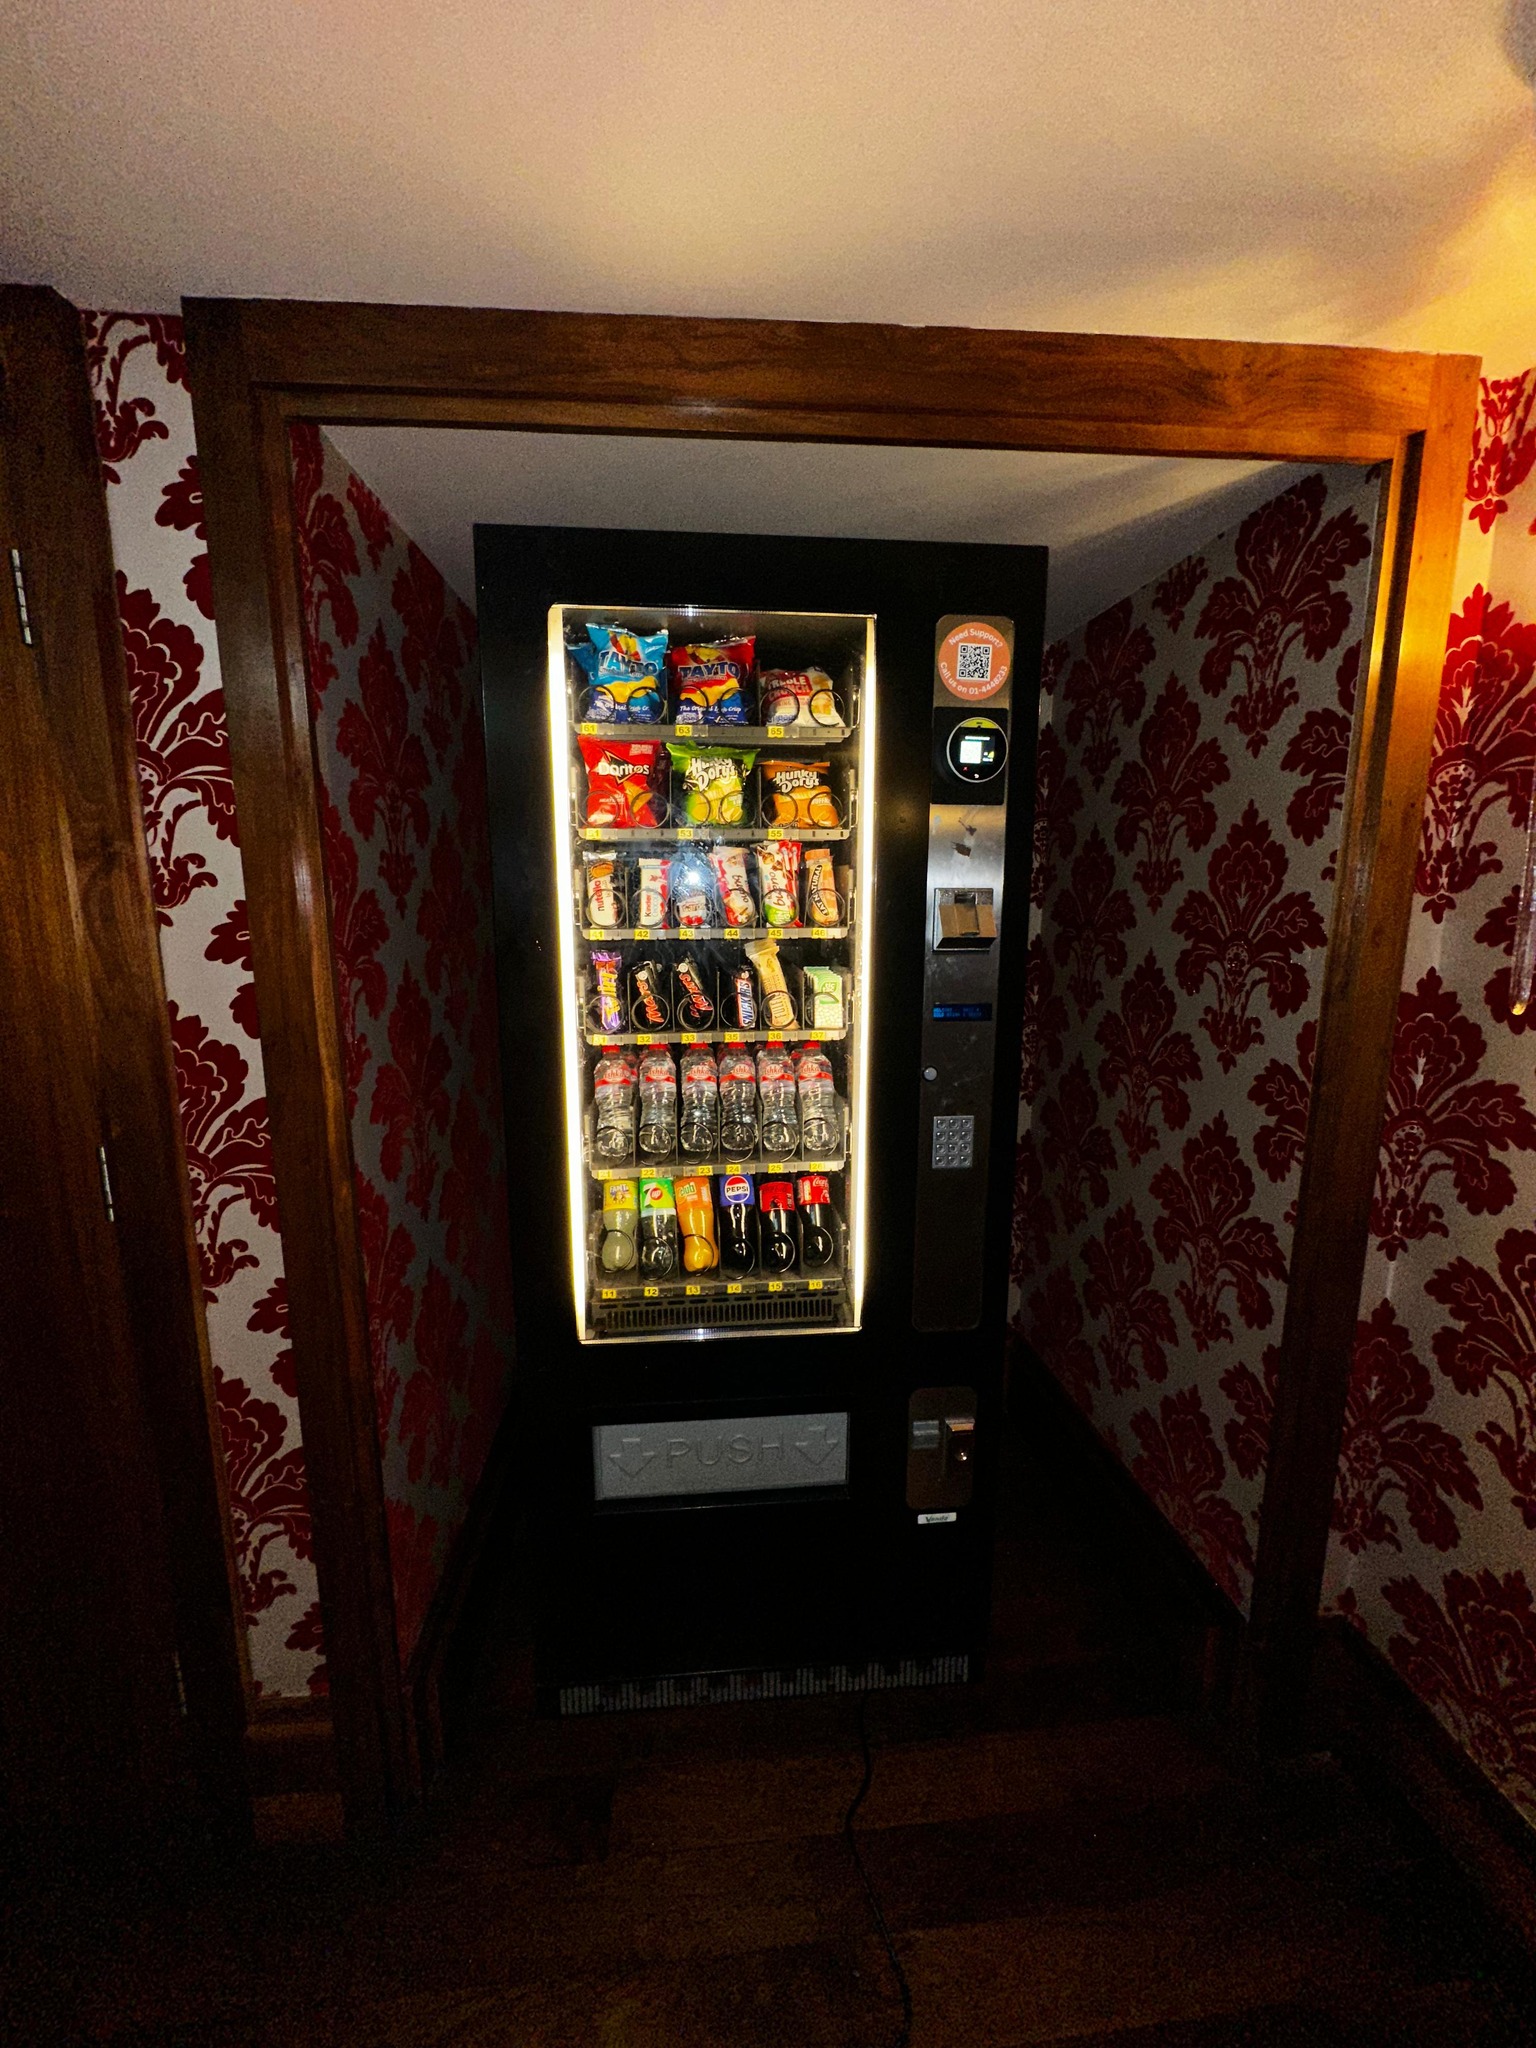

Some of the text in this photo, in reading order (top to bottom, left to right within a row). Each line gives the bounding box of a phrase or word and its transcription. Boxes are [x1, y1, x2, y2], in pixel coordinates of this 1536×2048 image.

[948, 628, 1003, 648] Need Support?
[598, 651, 659, 676] TAYTO
[678, 661, 740, 679] TAYTO
[940, 662, 951, 680] Call
[948, 678, 957, 688] us
[957, 685, 967, 693] on
[583, 723, 595, 732] 61
[678, 726, 691, 734] 63
[597, 761, 650, 777] Doritos
[695, 766, 738, 791] Dorys
[773, 769, 818, 785] Hunky
[779, 778, 820, 793] Dorys
[679, 829, 692, 837] 53
[732, 874, 749, 903] bueno
[769, 871, 786, 906] bueno
[593, 880, 605, 912] nutella
[816, 901, 829, 916] EAT
[636, 930, 649, 938] 42
[770, 929, 782, 937] 45
[814, 929, 826, 937] 46
[639, 1035, 651, 1043] 32
[683, 1034, 695, 1042] 33
[727, 1033, 738, 1041] 35
[770, 1032, 781, 1040] 36
[812, 1031, 824, 1039] 37
[729, 1165, 740, 1173] 24
[770, 1164, 782, 1172] 25
[643, 1182, 658, 1207] 7
[726, 1185, 749, 1193] PEPSI
[667, 1433, 783, 1468] PUSH
